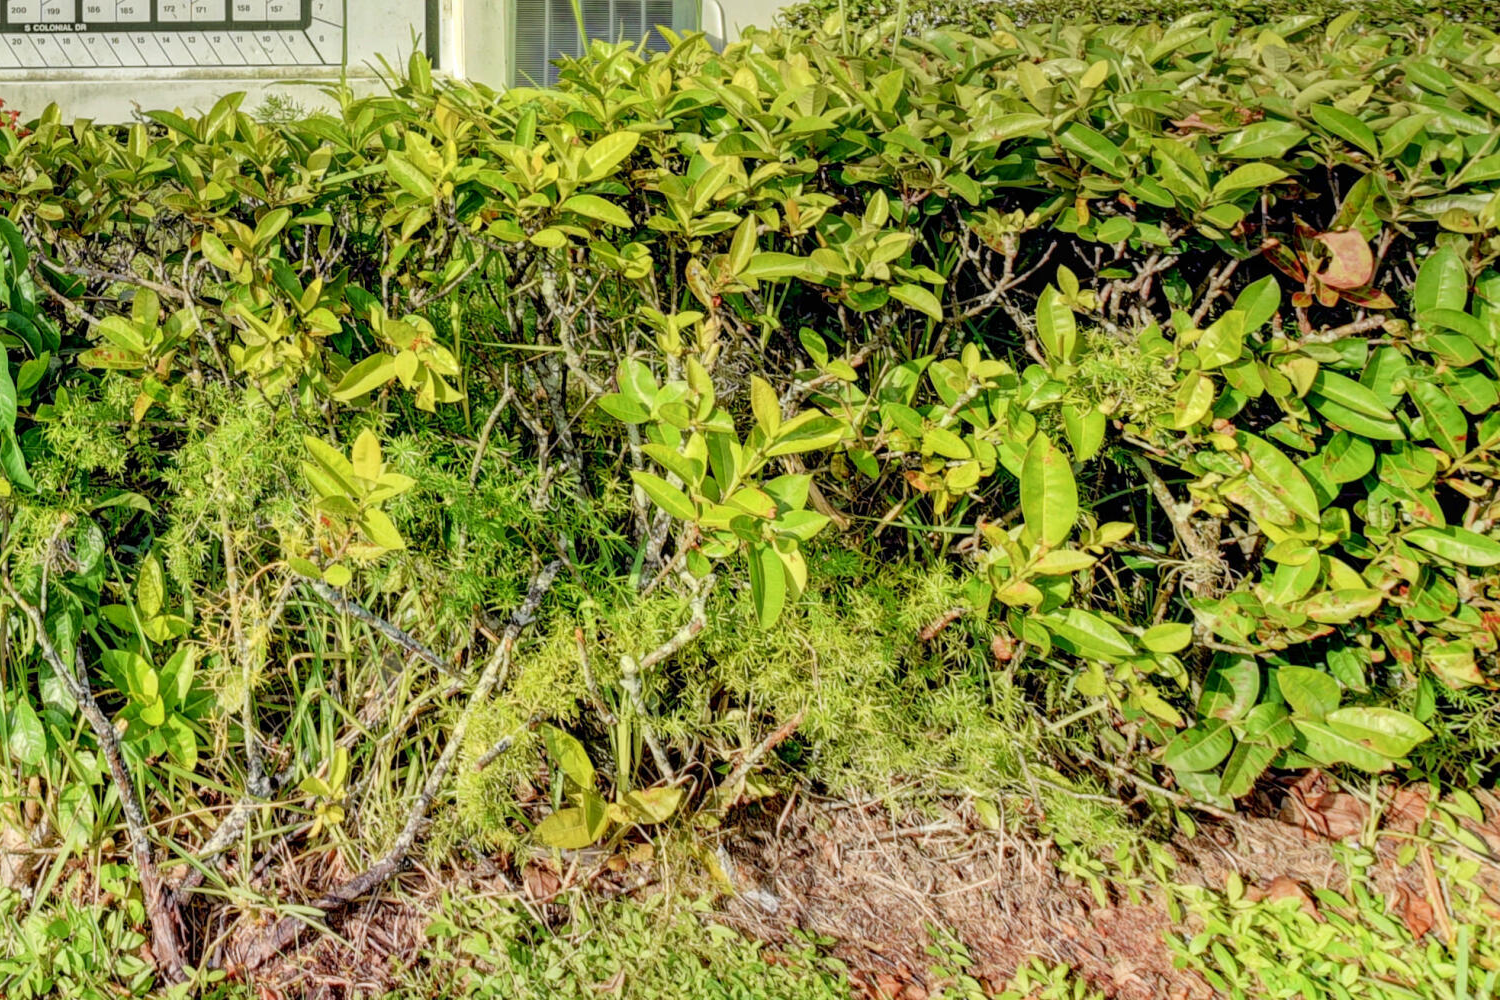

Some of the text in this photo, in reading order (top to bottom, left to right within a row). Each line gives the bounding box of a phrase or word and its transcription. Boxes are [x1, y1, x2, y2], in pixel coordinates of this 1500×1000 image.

[24, 23, 87, 31] S COLONIAL DR
